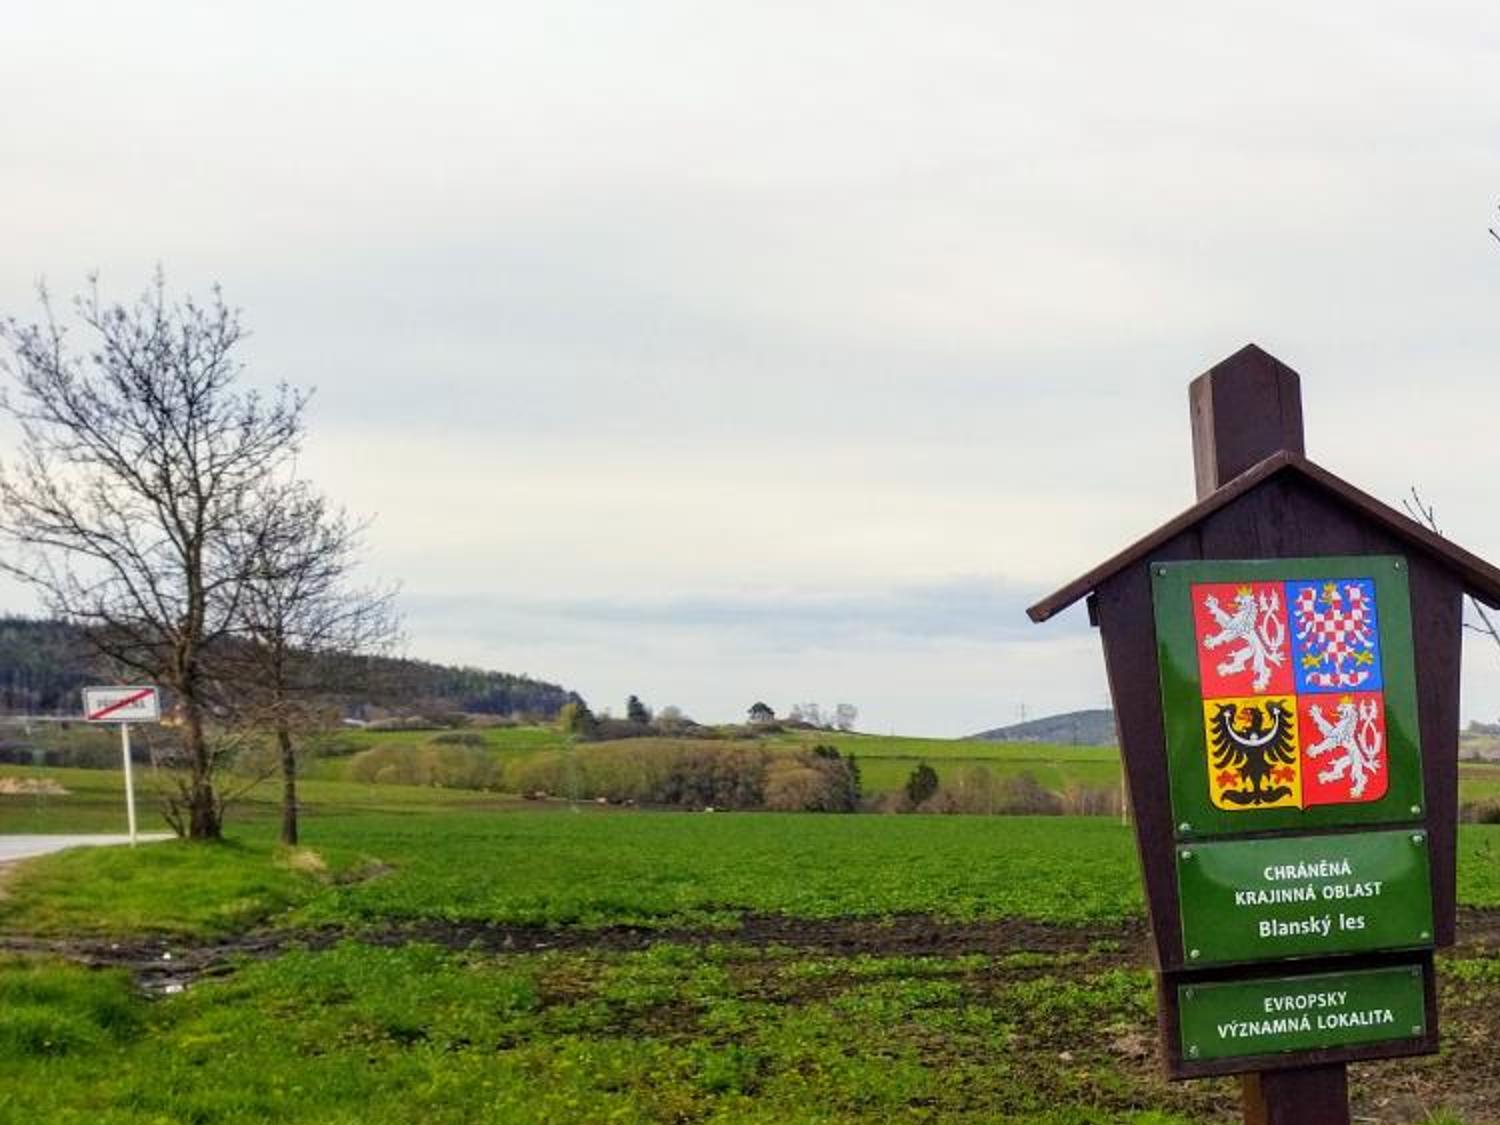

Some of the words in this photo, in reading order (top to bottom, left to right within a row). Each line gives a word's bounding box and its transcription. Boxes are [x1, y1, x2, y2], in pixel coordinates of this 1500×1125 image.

[1264, 858, 1351, 881] CHRÁNĚNÁ
[1235, 884, 1316, 905] KRAJINNÁ
[1323, 882, 1383, 899] OBLAST
[1259, 915, 1331, 938] Blanský
[1339, 914, 1366, 931] les
[1264, 992, 1347, 1012] EVROPSKY
[1217, 1017, 1311, 1039] VÝZNAMNÁ
[1318, 1010, 1394, 1029] LOKALITA
